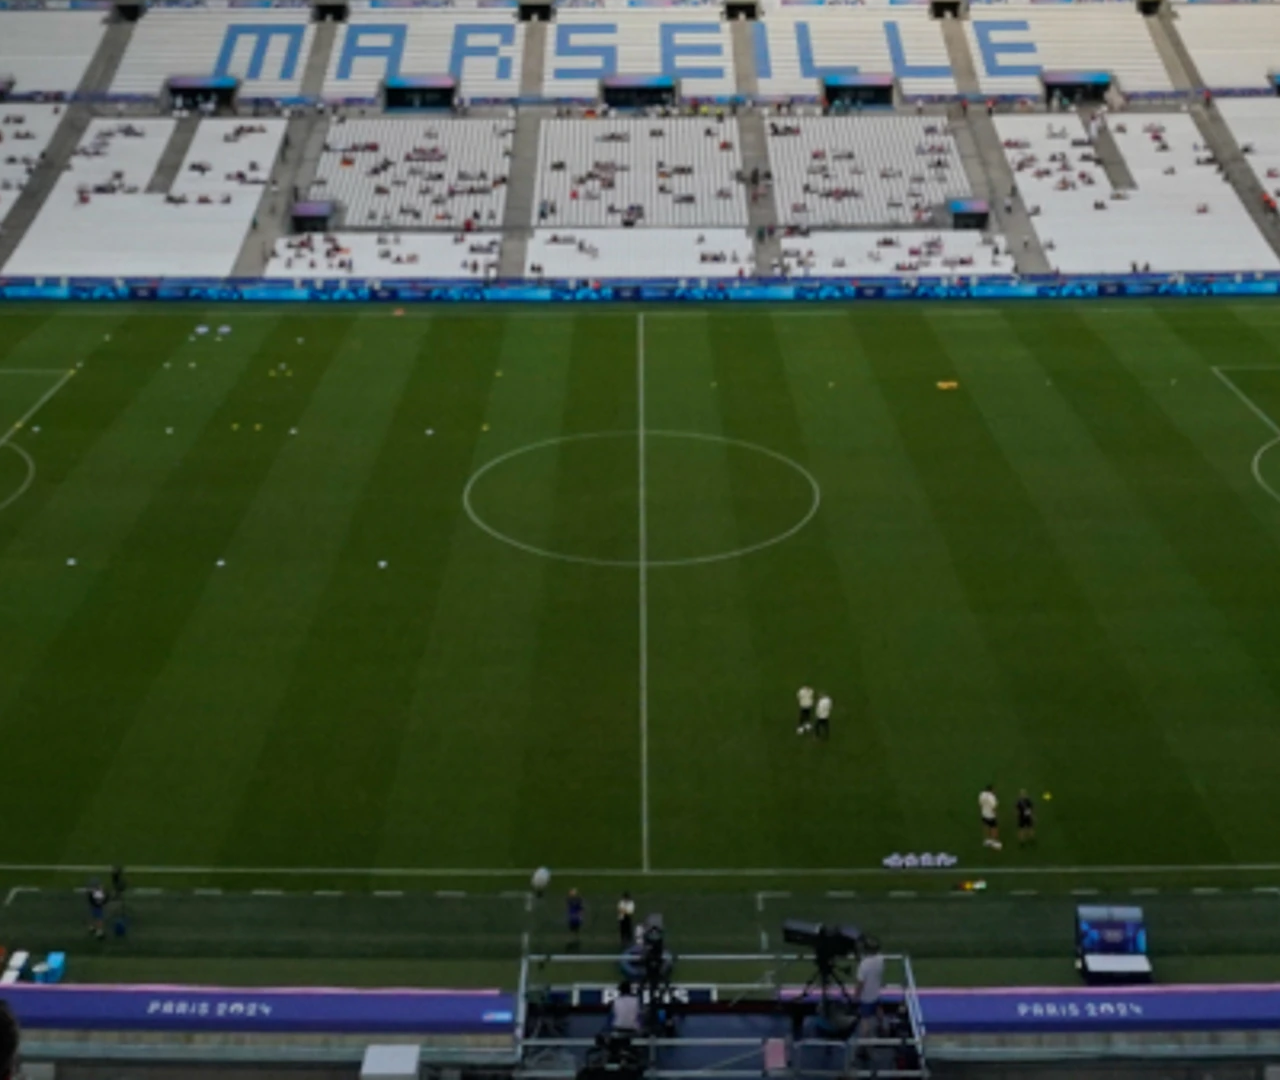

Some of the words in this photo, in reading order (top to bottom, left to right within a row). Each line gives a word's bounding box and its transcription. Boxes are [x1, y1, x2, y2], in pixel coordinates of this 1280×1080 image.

[210, 22, 1042, 80] MARSEILLE
[146, 999, 210, 1017] PARIS
[215, 1001, 273, 1018] 2024
[1016, 1001, 1080, 1018] PARIS
[1084, 1001, 1144, 1018] 2024
